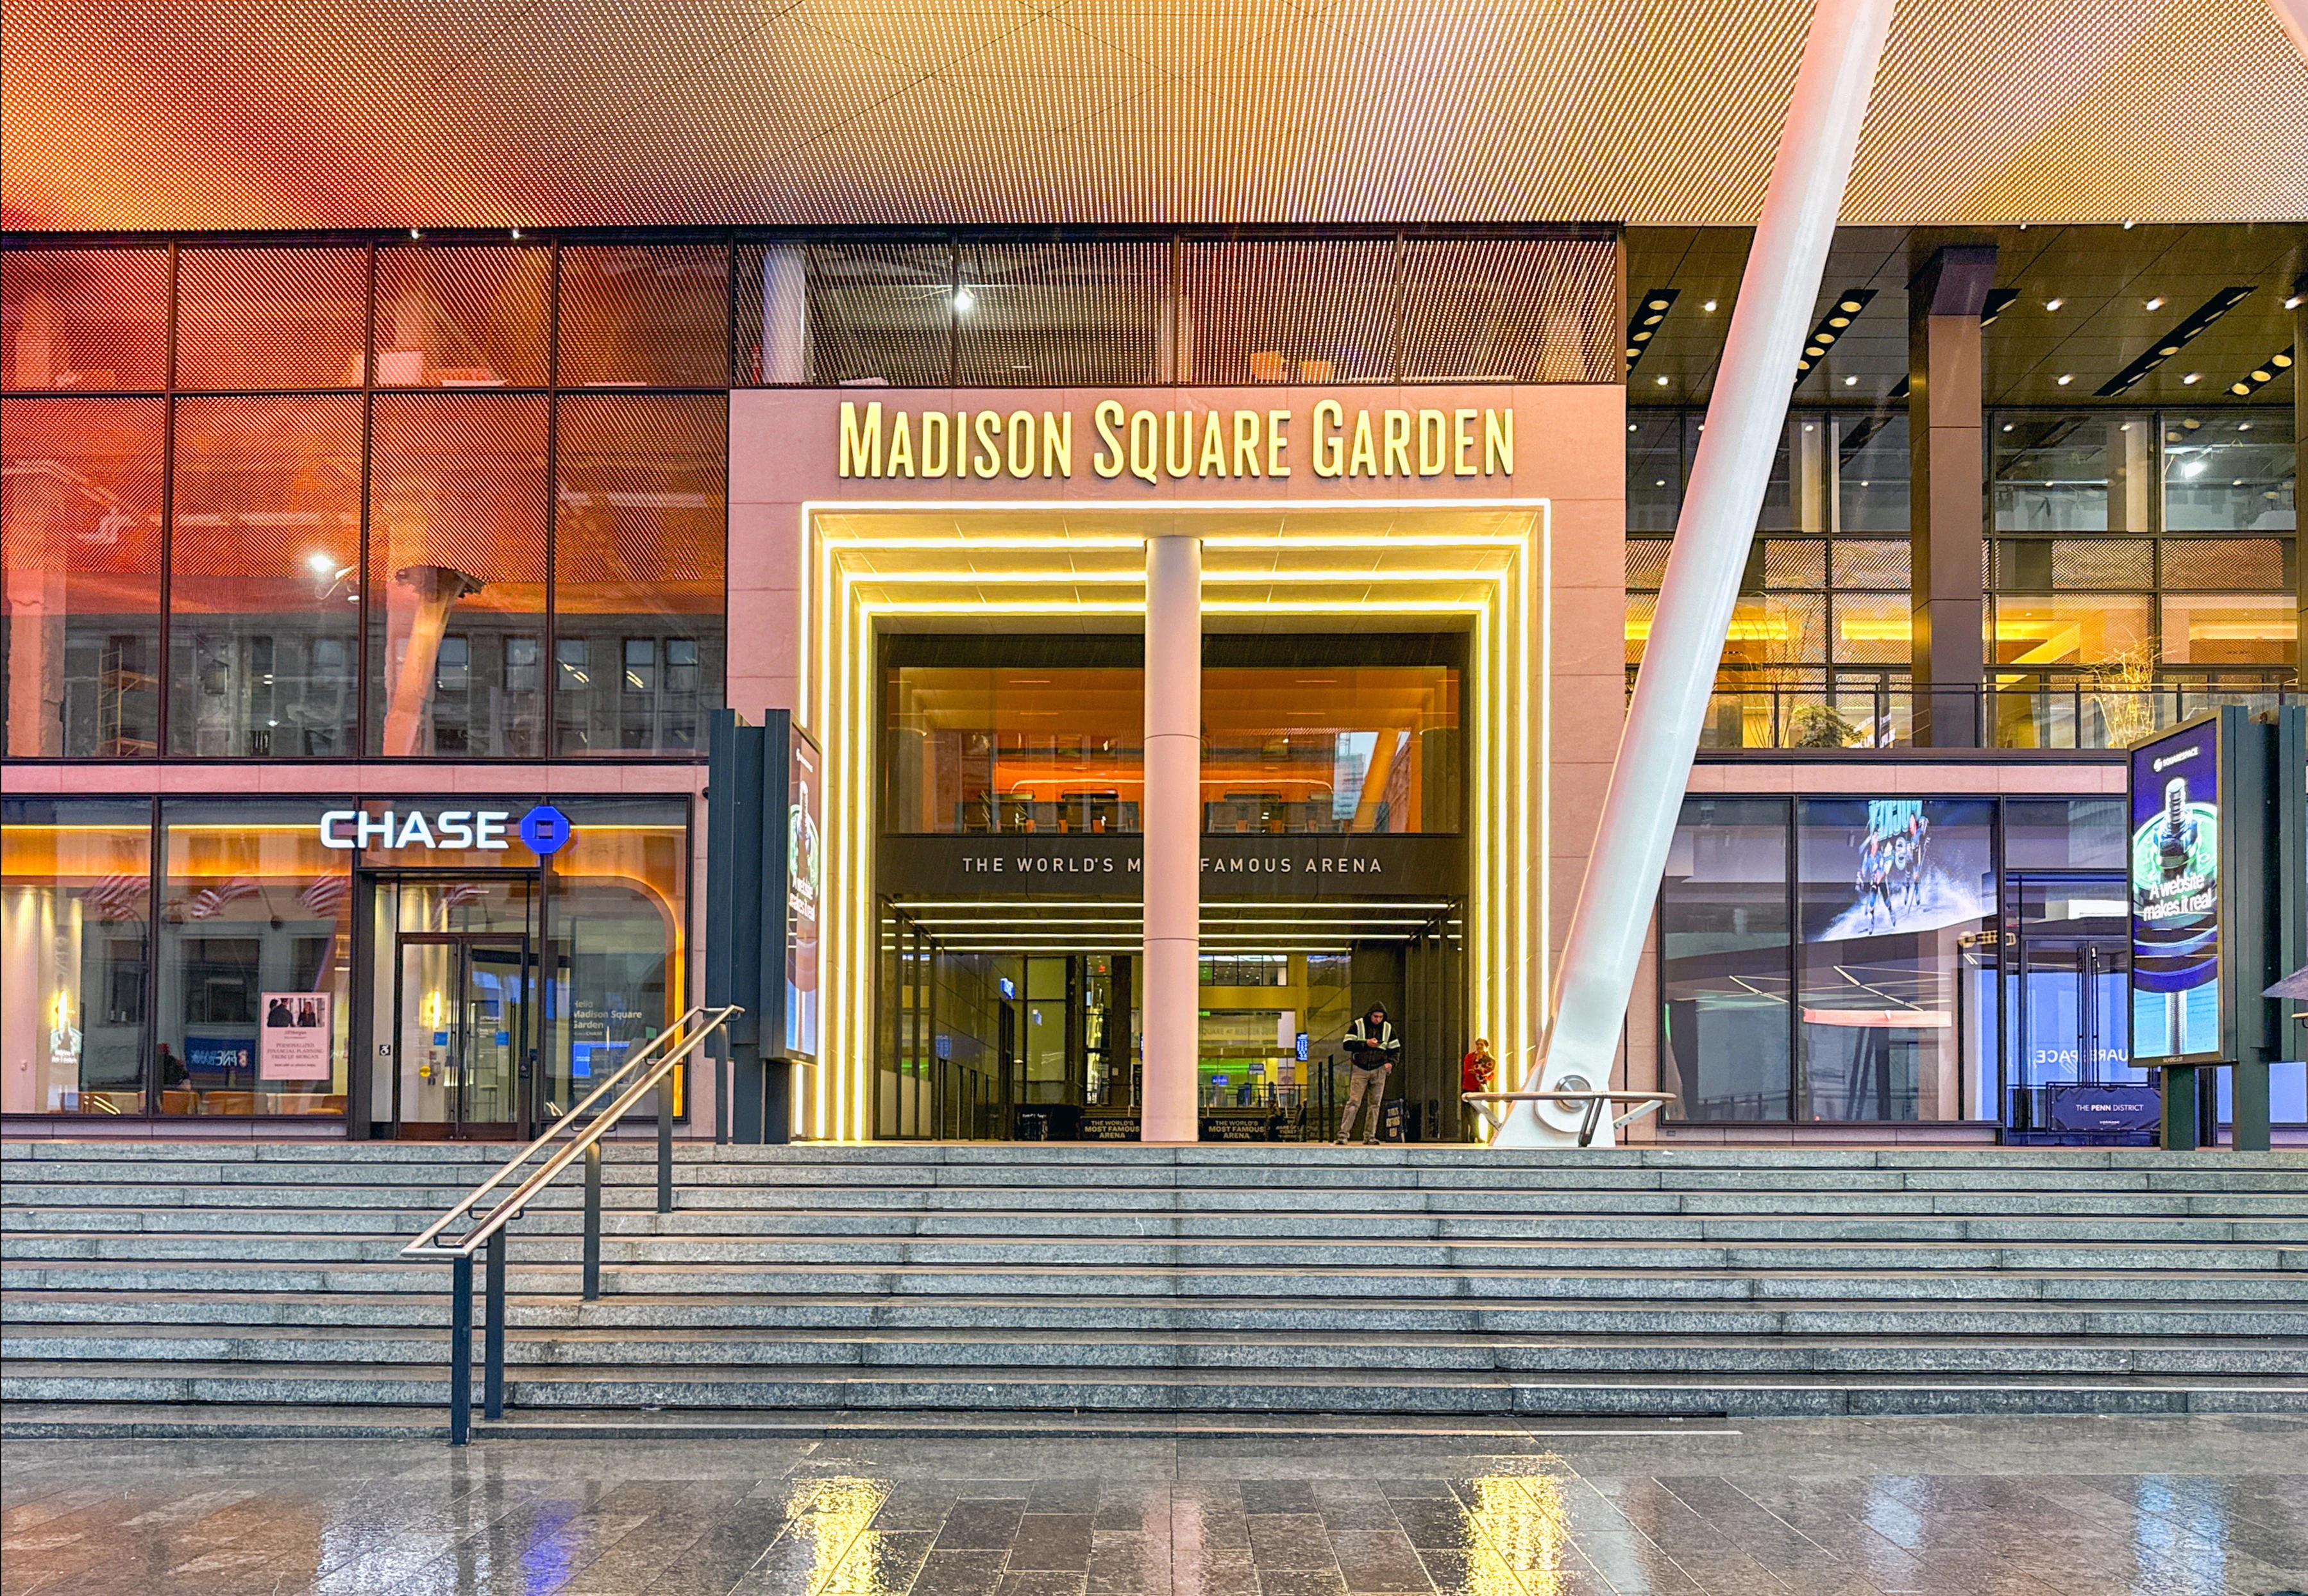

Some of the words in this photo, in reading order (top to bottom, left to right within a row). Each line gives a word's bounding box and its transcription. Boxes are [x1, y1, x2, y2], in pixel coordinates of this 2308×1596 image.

[839, 401, 1072, 478] MADISON
[1094, 400, 1291, 485] SQUARE
[1313, 399, 1514, 477] GARDEN
[321, 811, 509, 848] CHASE
[963, 858, 1004, 873] THE
[1016, 858, 1114, 873] WORLD'S
[1200, 858, 1292, 873] FAMOUS
[1305, 858, 1382, 873] ARENA
[2149, 882, 2160, 900] A
[2160, 873, 2205, 897] website
[2143, 900, 2180, 921] makes
[2181, 895, 2189, 912] it
[2189, 887, 2212, 911] real
[611, 1011, 642, 1020] Square
